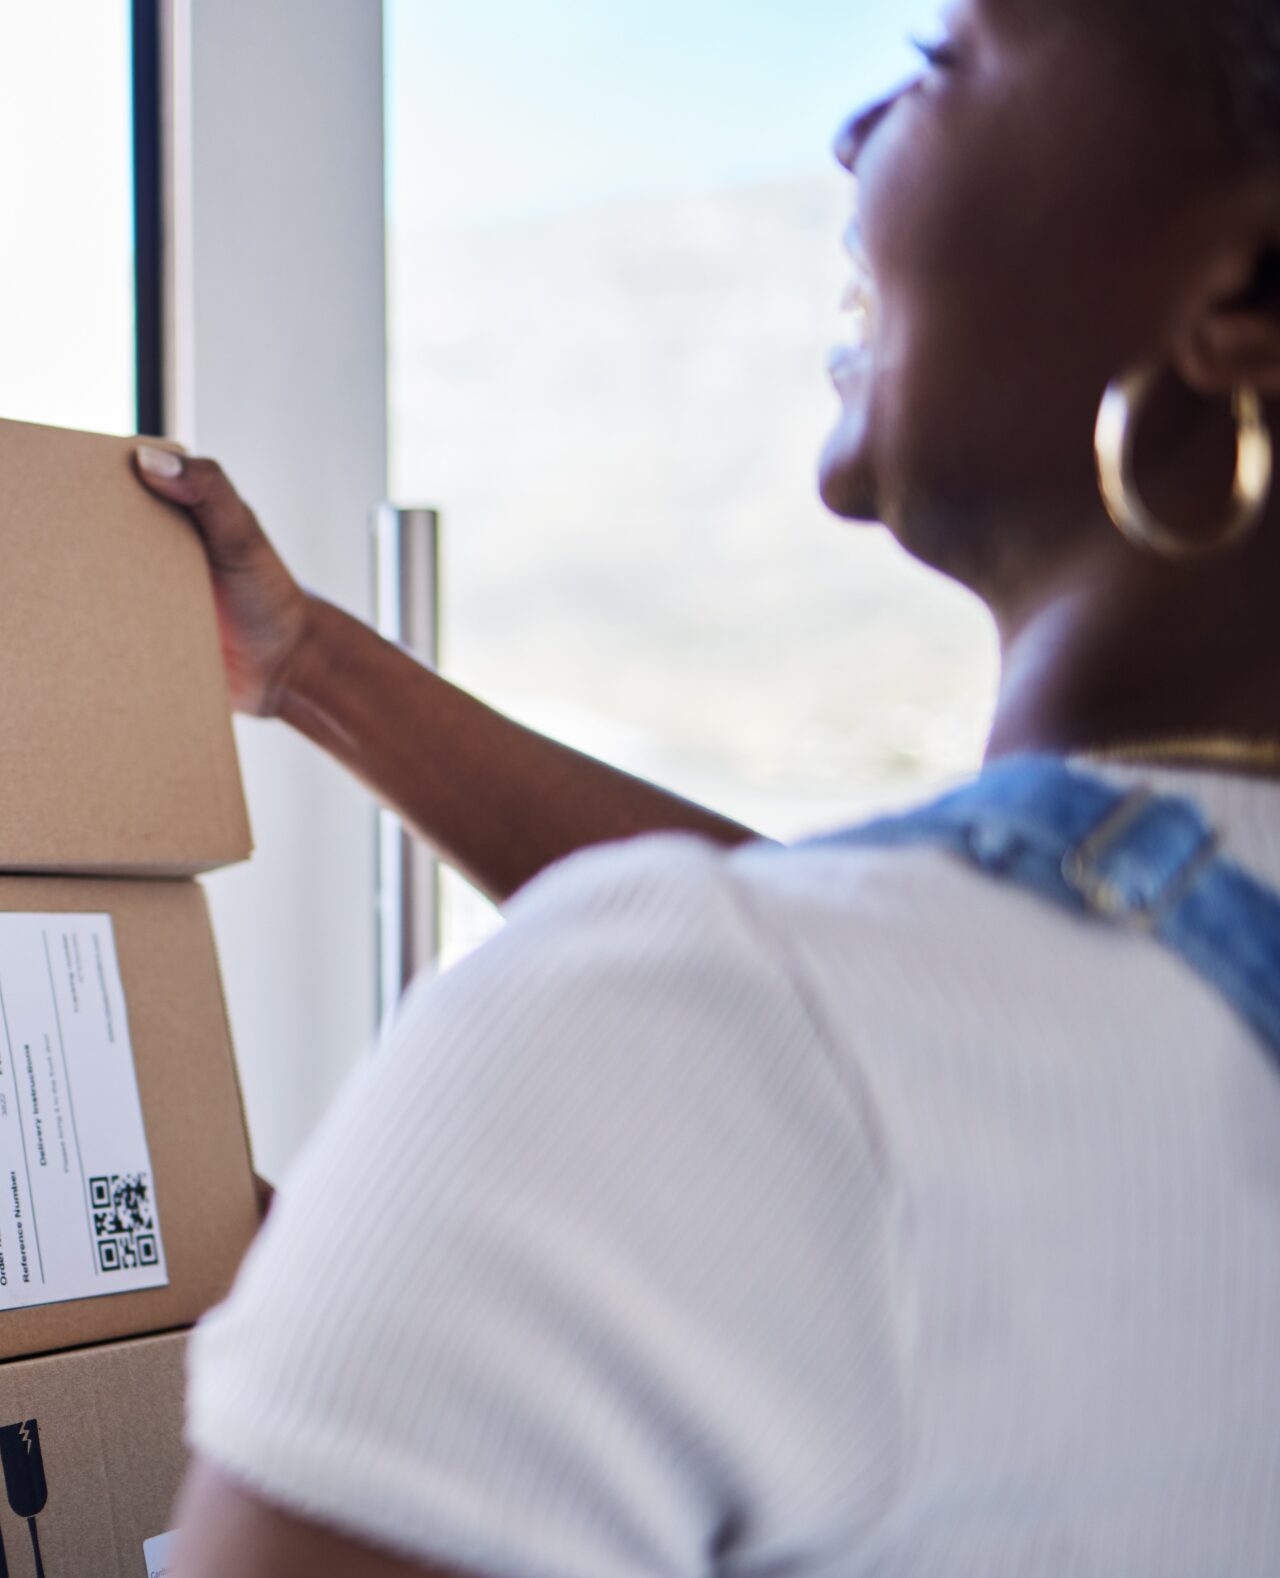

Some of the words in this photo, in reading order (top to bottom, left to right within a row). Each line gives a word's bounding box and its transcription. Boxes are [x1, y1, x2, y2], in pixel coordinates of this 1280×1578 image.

[23, 1043, 40, 1116] Instructions
[34, 1117, 48, 1167] Delivery
[16, 1221, 31, 1284] Reference
